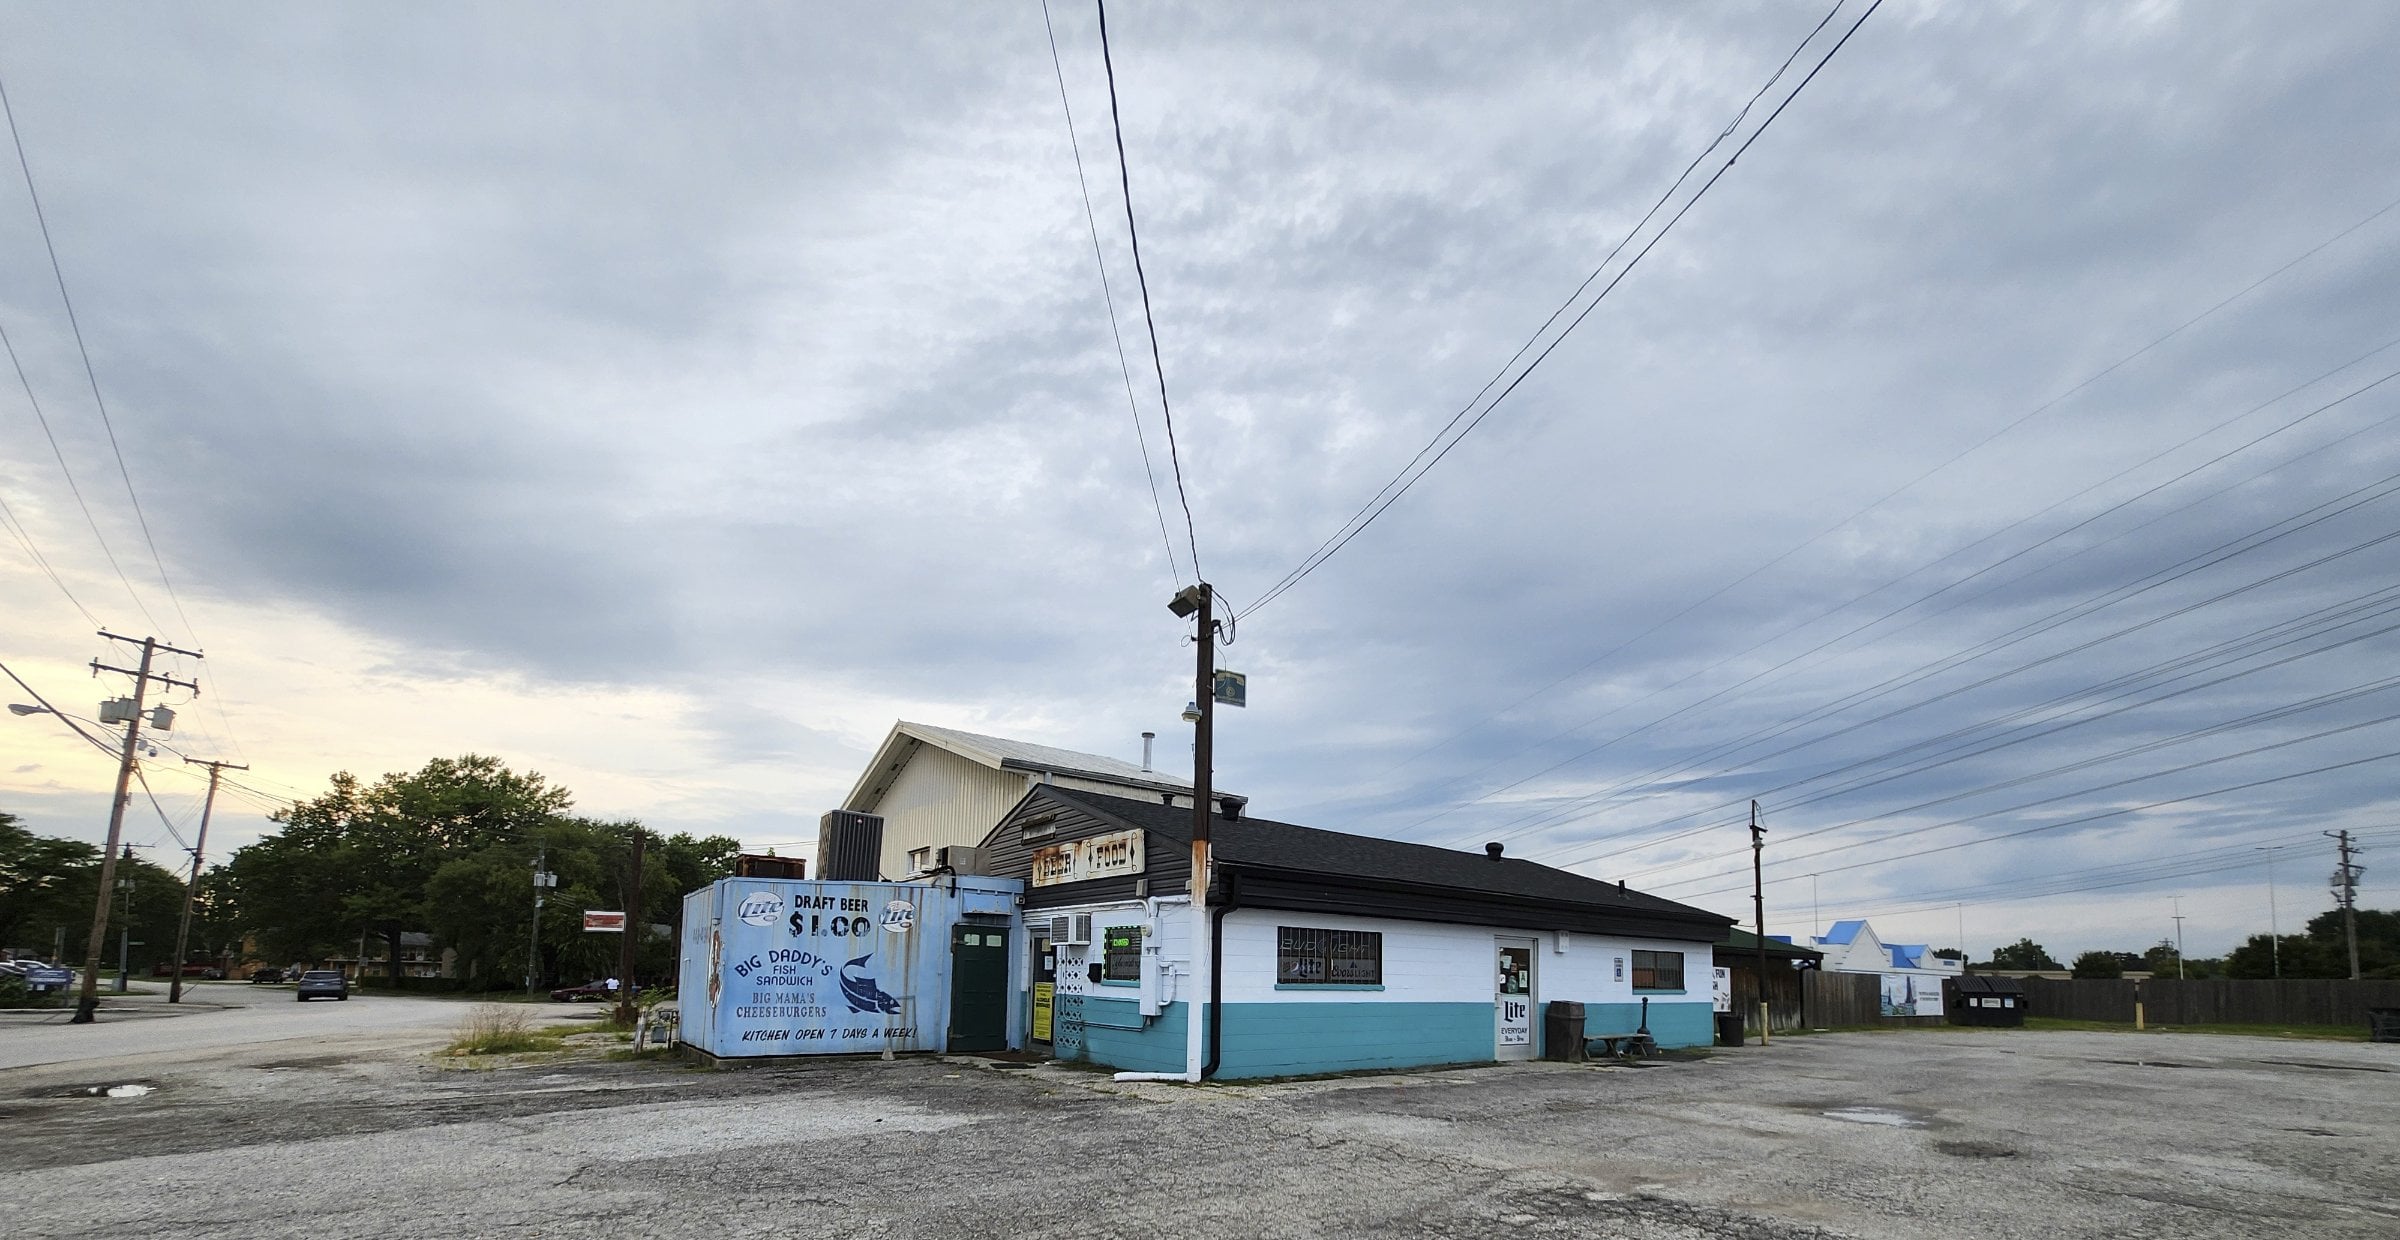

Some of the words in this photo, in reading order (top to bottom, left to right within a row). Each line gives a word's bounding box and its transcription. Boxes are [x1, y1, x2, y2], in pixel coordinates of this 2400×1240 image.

[1096, 842, 1127, 869] FOOD
[739, 900, 784, 919] Lite
[794, 894, 836, 911] DRAFT
[840, 897, 869, 912] BEER
[788, 911, 871, 938] $1.00
[879, 907, 914, 926] Lite
[734, 954, 762, 977] BIG
[768, 948, 833, 976] DADDY'S
[773, 965, 797, 975] FISH
[756, 976, 813, 986] SANDWICH
[752, 992, 771, 1004] BIG
[776, 992, 815, 1004] MAMA'S
[736, 1006, 827, 1018] CHEESEBURGERS
[1503, 1000, 1526, 1023] Lite
[742, 1029, 791, 1041] KITCHEN
[795, 1028, 825, 1040] OPEN
[830, 1028, 837, 1039] 7
[842, 1028, 868, 1039] DAYS
[872, 1028, 879, 1038] A
[883, 1027, 918, 1039] WEEK!
